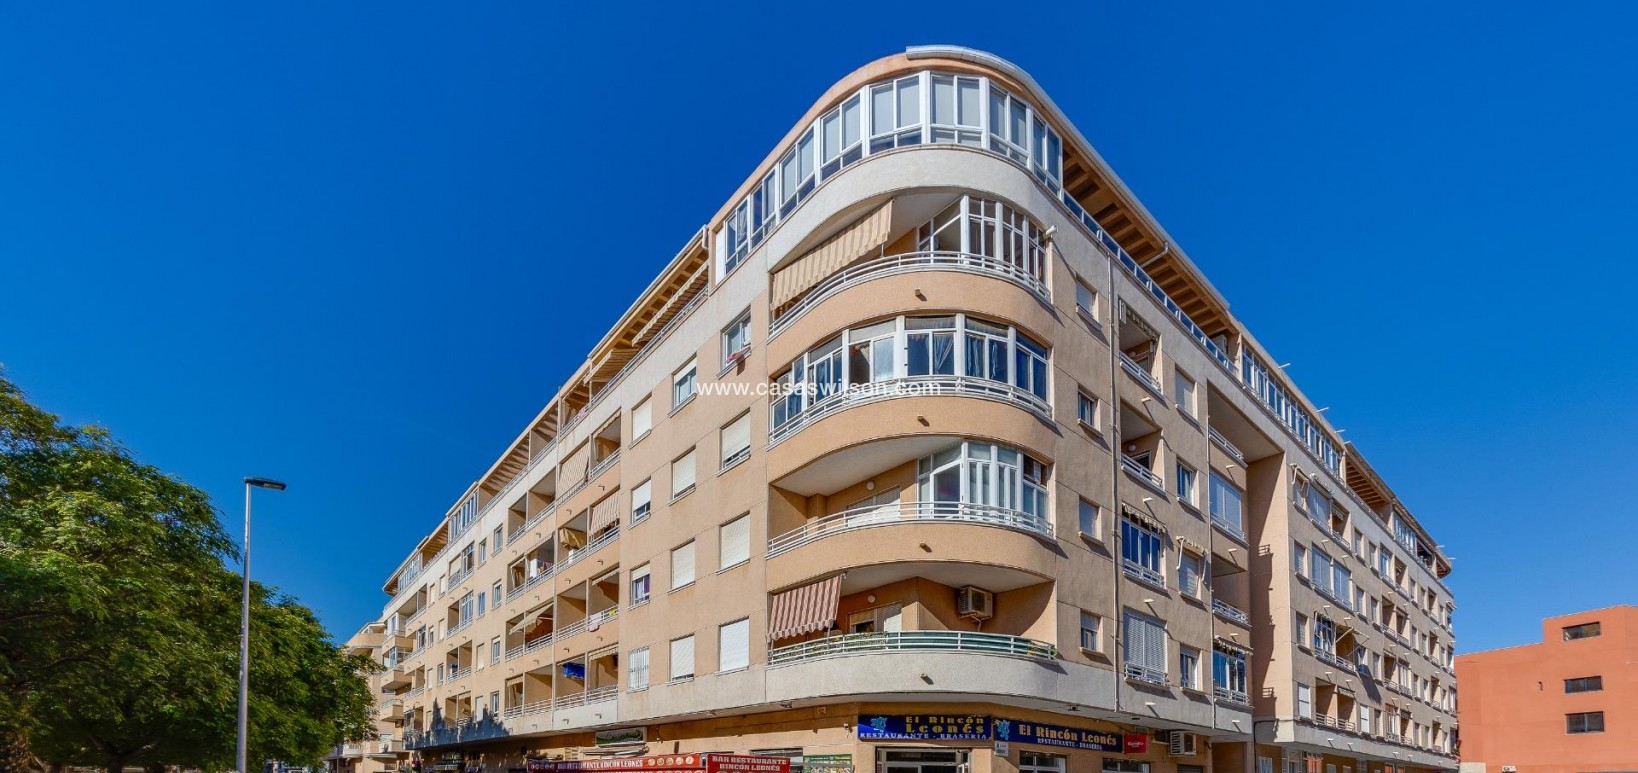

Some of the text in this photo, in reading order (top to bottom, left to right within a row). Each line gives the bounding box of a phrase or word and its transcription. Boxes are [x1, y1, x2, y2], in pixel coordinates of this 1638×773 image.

[905, 716, 984, 724] El Rincón
[906, 723, 984, 733] Leonés
[1018, 724, 1031, 736] El
[1036, 726, 1078, 741] Rincón
[1082, 731, 1117, 746] Leonés
[1037, 738, 1076, 748] RESTAURANTE
[730, 757, 787, 765] RESTAURANTE
[719, 763, 780, 772] RINCÓN LEONÉS
